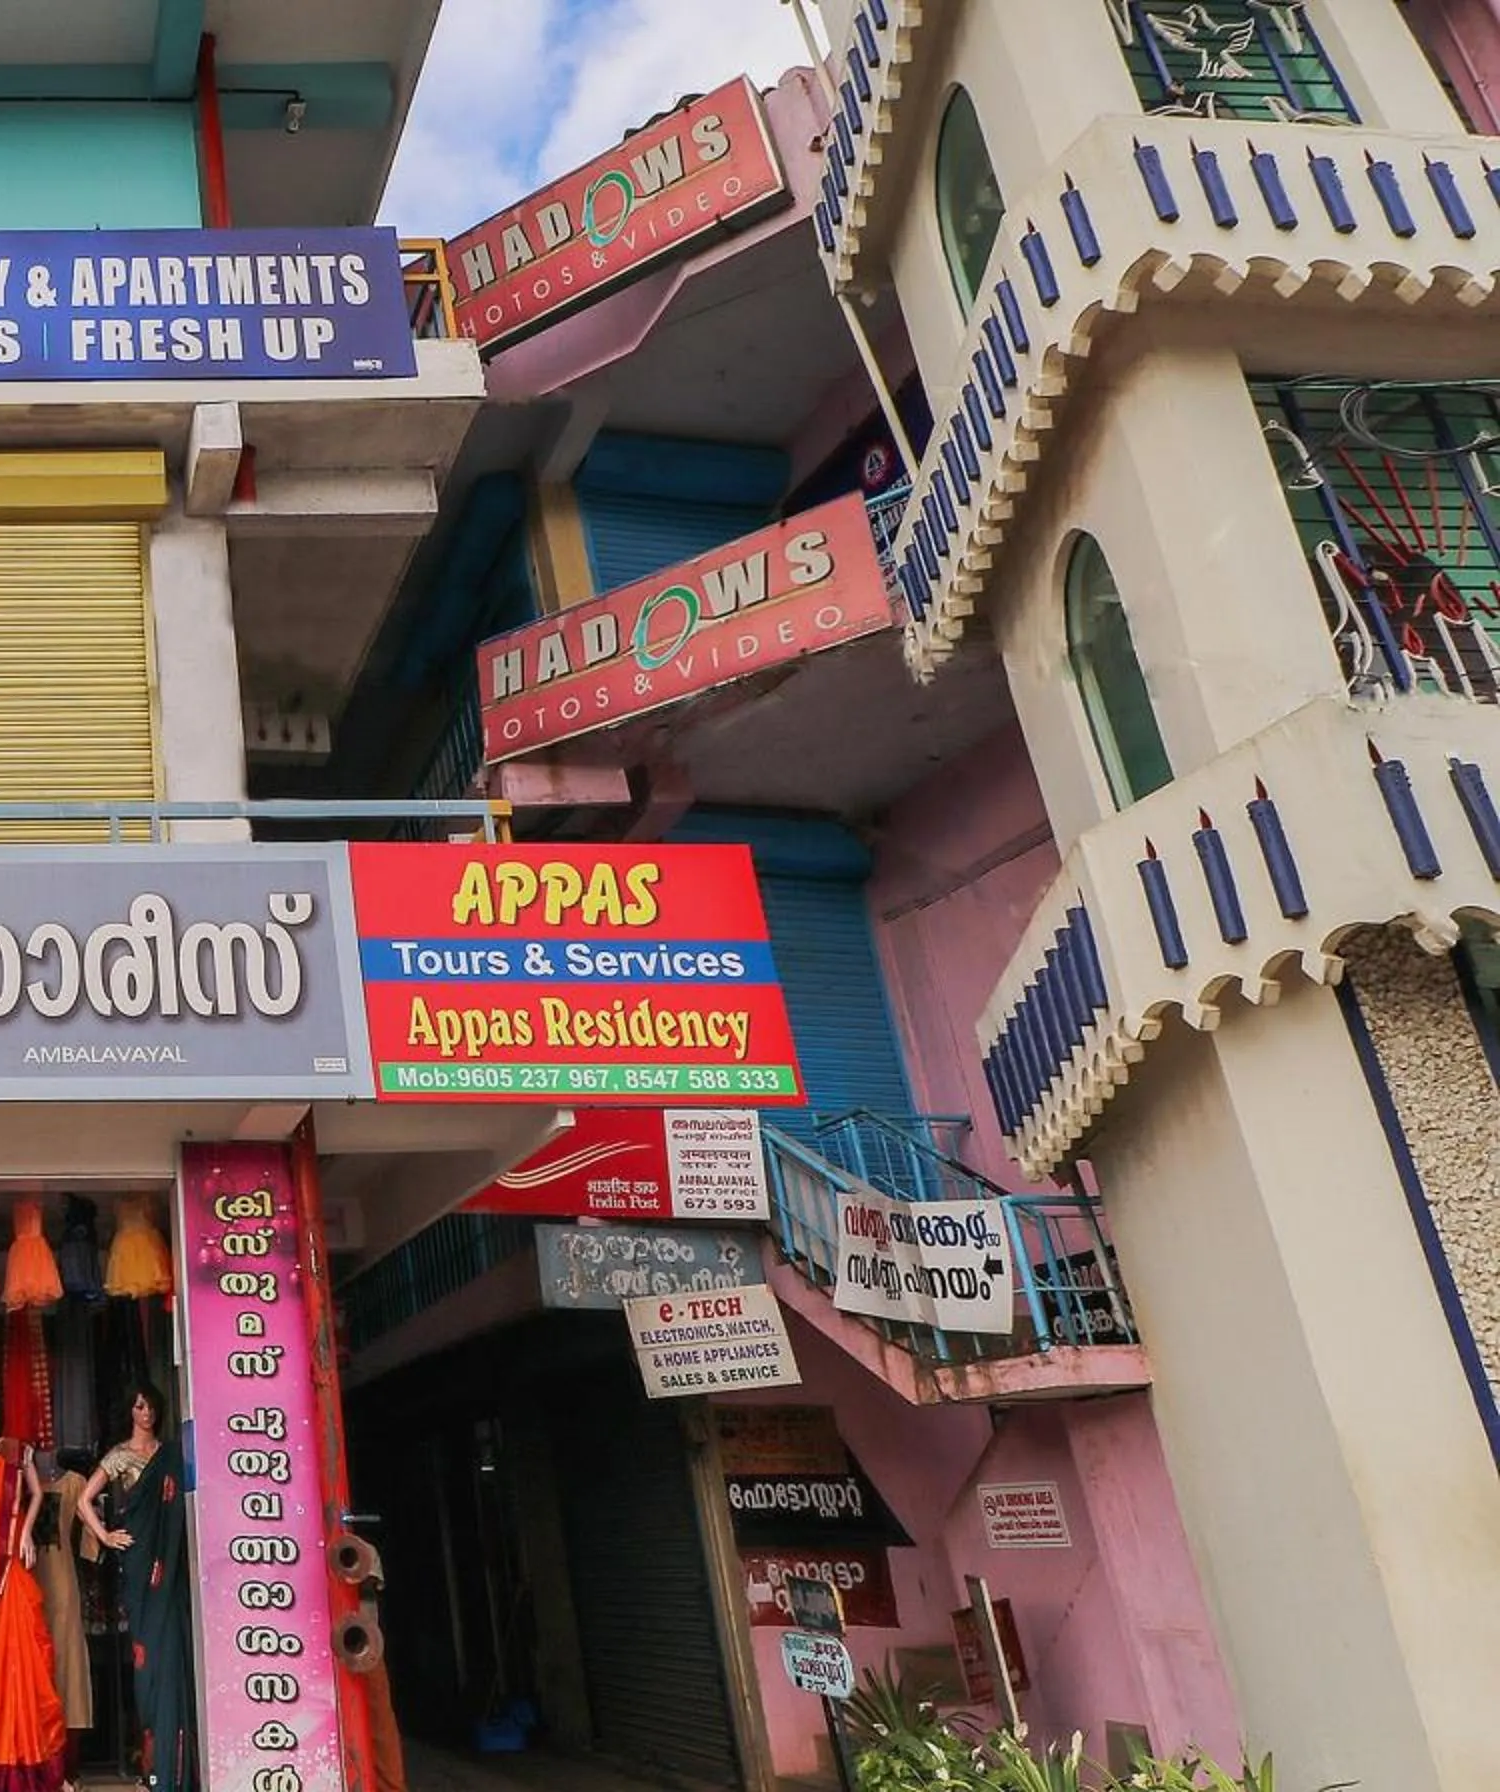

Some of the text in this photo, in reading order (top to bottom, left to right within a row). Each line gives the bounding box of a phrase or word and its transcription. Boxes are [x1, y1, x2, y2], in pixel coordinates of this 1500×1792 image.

[450, 114, 731, 300] HADOWS
[591, 251, 608, 270] &
[621, 176, 742, 250] VIDEO
[26, 264, 59, 308] &
[71, 254, 371, 307] APARTMENTS
[71, 317, 244, 362] FRESH
[262, 316, 336, 362] UP
[633, 673, 653, 696] &
[675, 605, 843, 679] VIDEO
[451, 861, 661, 925] APPAS
[390, 941, 746, 977] Tours & Services
[406, 995, 750, 1058] Appas Residency
[23, 1044, 188, 1065] AMBALAVAYAL
[519, 1069, 560, 1088] 237
[626, 1070, 678, 1089] 8547
[688, 1071, 729, 1090] 588
[738, 1071, 780, 1090] 333
[588, 1193, 661, 1210] India Post
[683, 1197, 757, 1211] 673 593
[653, 1343, 780, 1368] & HOME APPLIANCES
[660, 1365, 780, 1388] SALES & SERVICE
